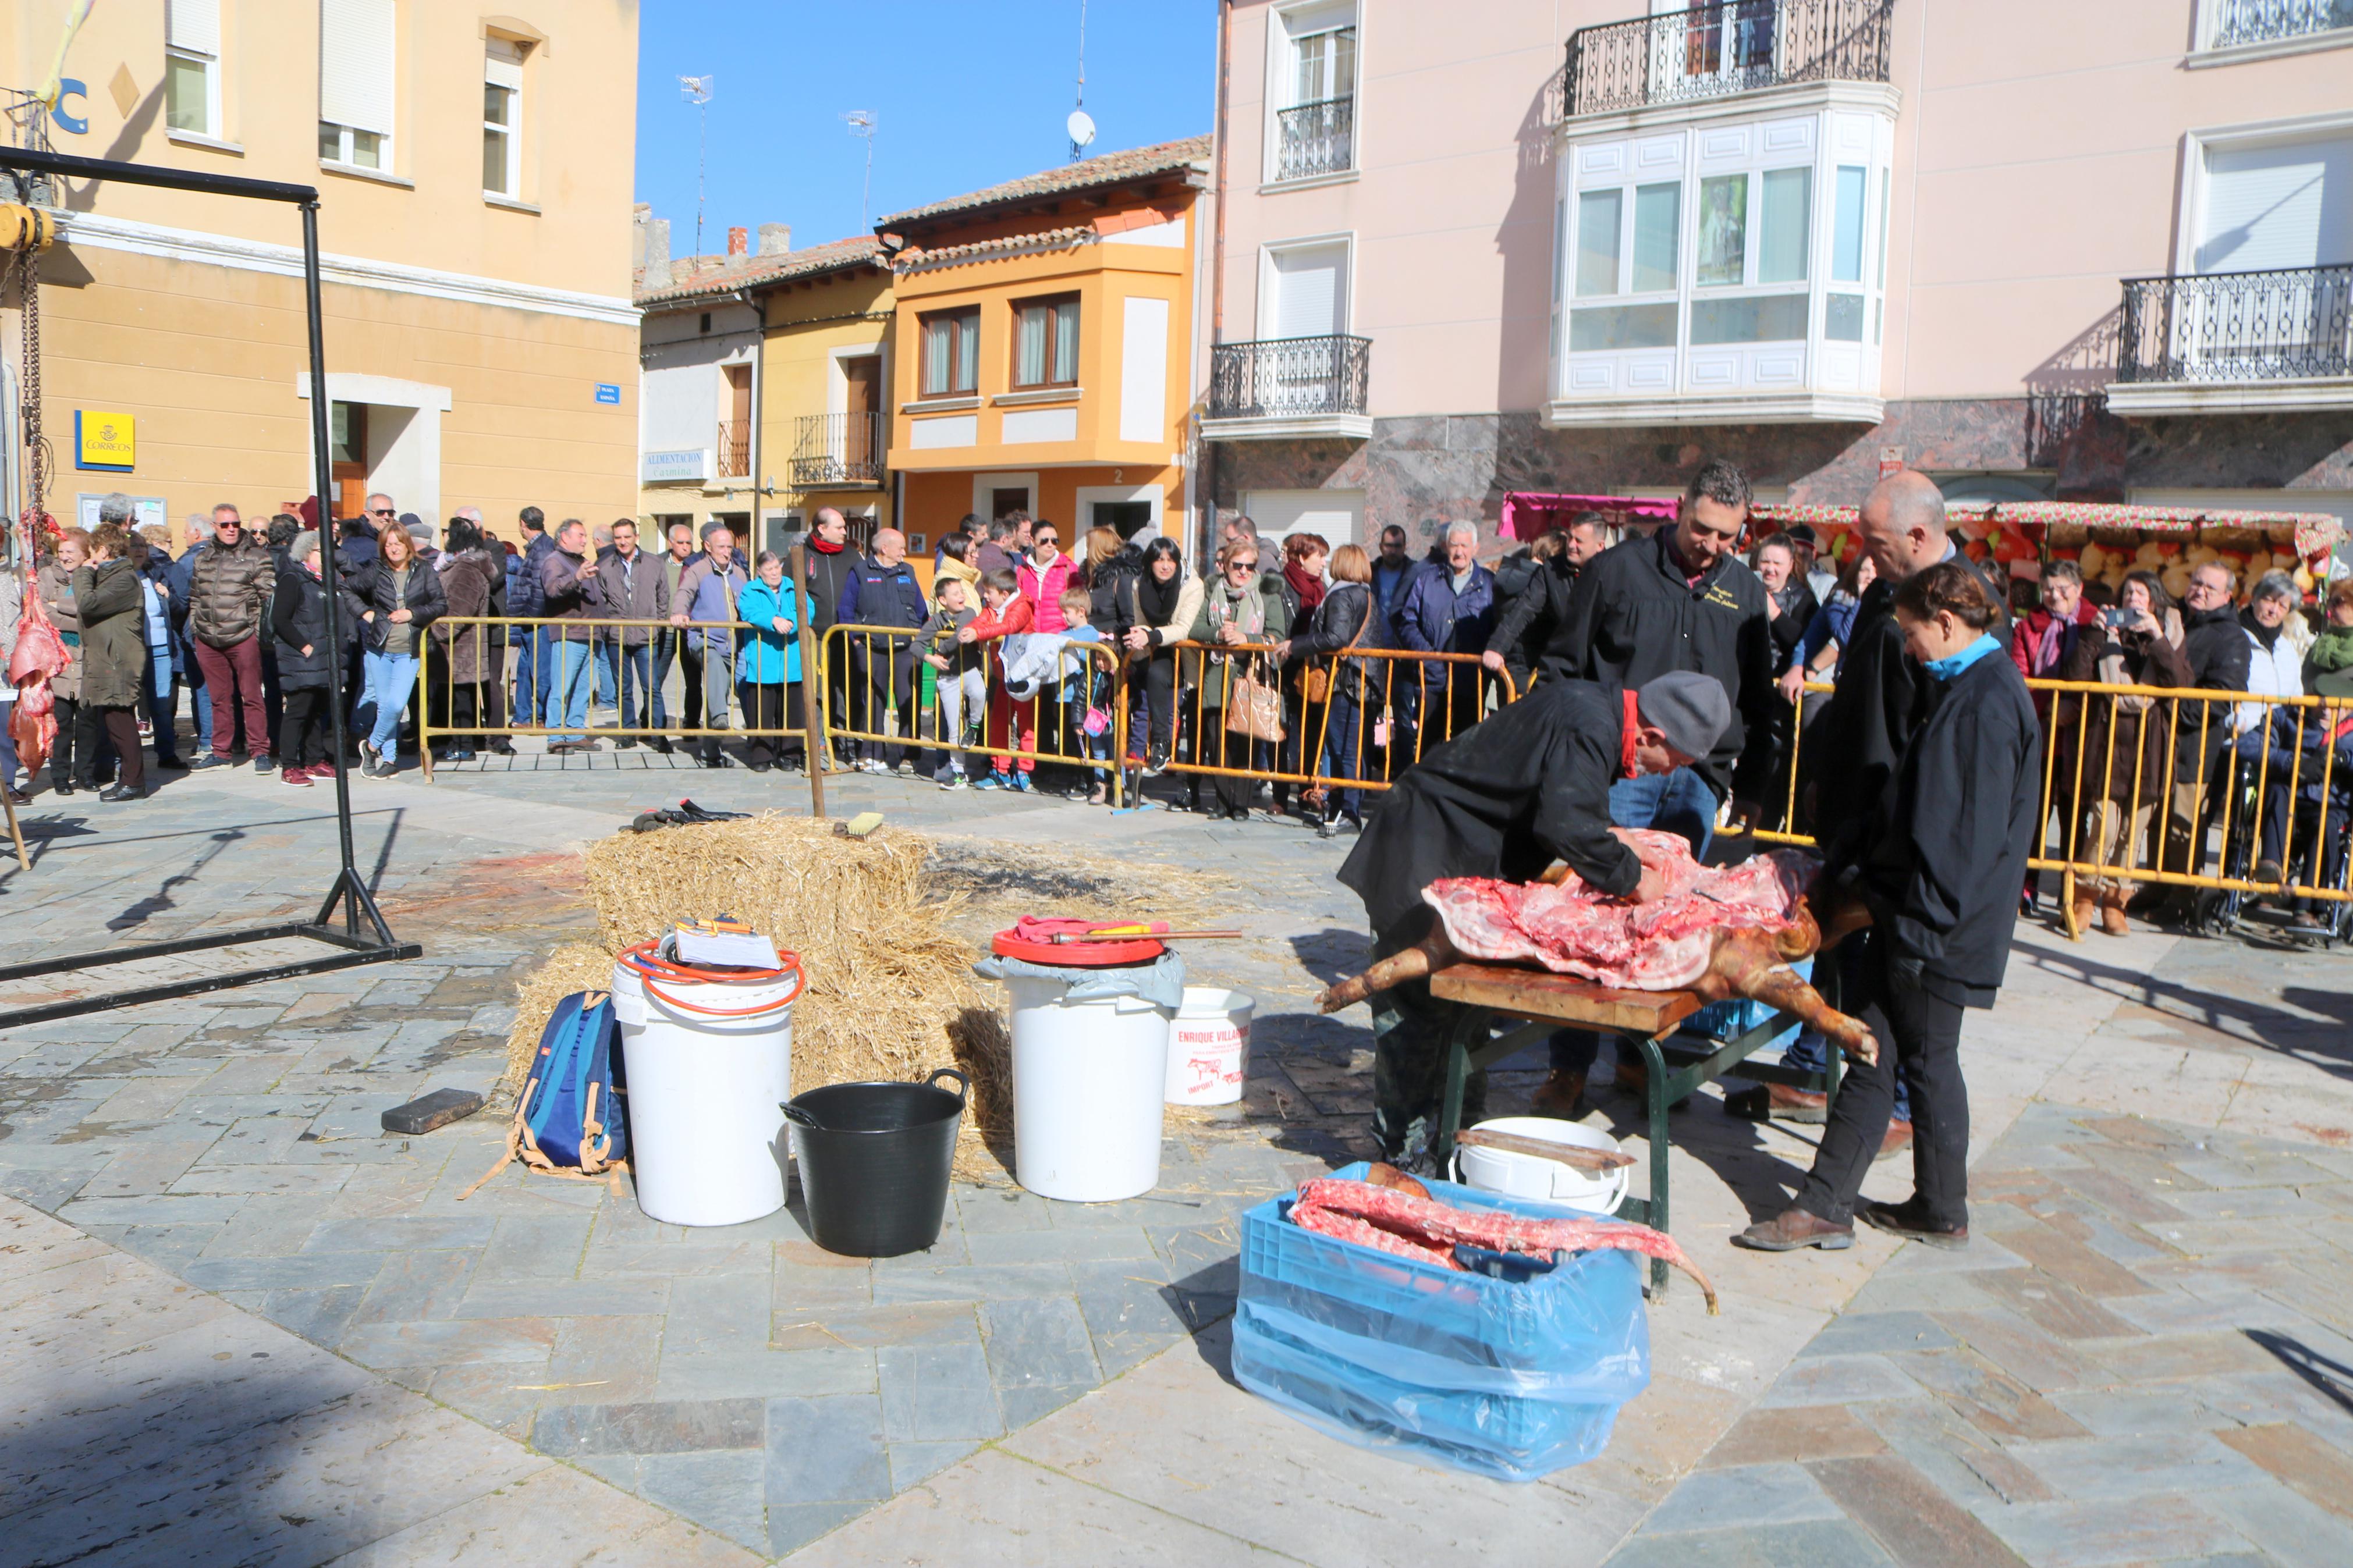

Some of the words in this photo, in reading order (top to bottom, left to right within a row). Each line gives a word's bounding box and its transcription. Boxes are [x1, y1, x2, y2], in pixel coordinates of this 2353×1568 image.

[86, 439, 131, 452] CORREOS
[647, 451, 701, 465] ALIMENTACION
[1114, 468, 1123, 484] 2
[1179, 1030, 1214, 1044] ENRIQUE
[1187, 1080, 1213, 1094] IMPORT
